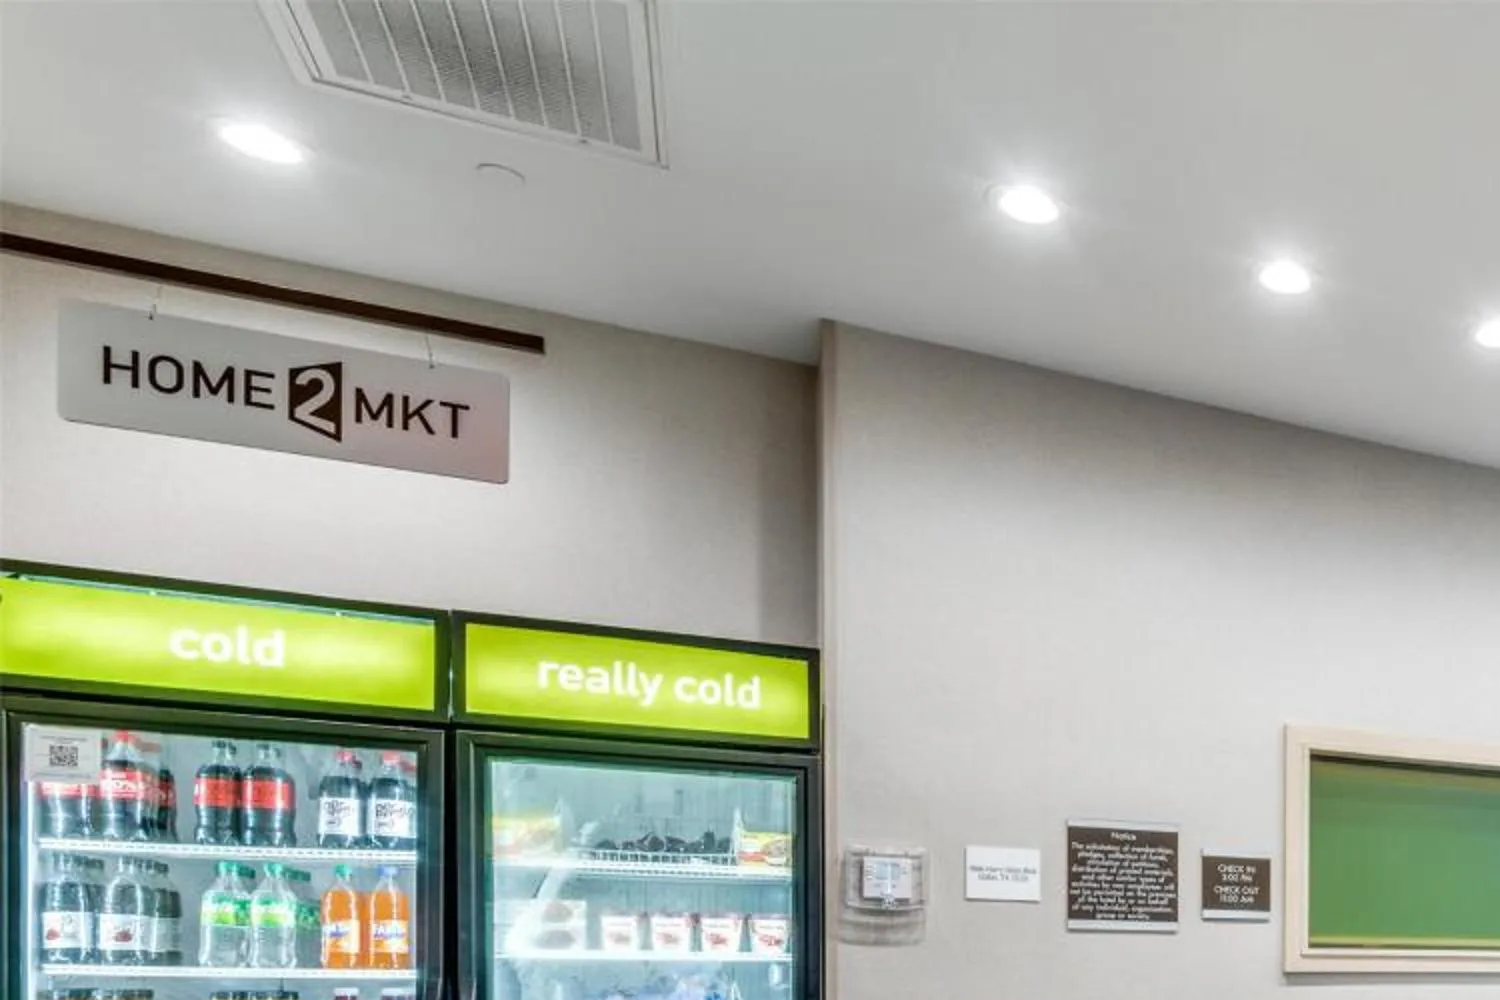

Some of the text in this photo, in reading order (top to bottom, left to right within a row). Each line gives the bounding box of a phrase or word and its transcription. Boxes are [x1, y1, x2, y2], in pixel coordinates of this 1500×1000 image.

[354, 386, 470, 439] MKT
[169, 627, 286, 668] cold
[537, 660, 762, 710] really cold
